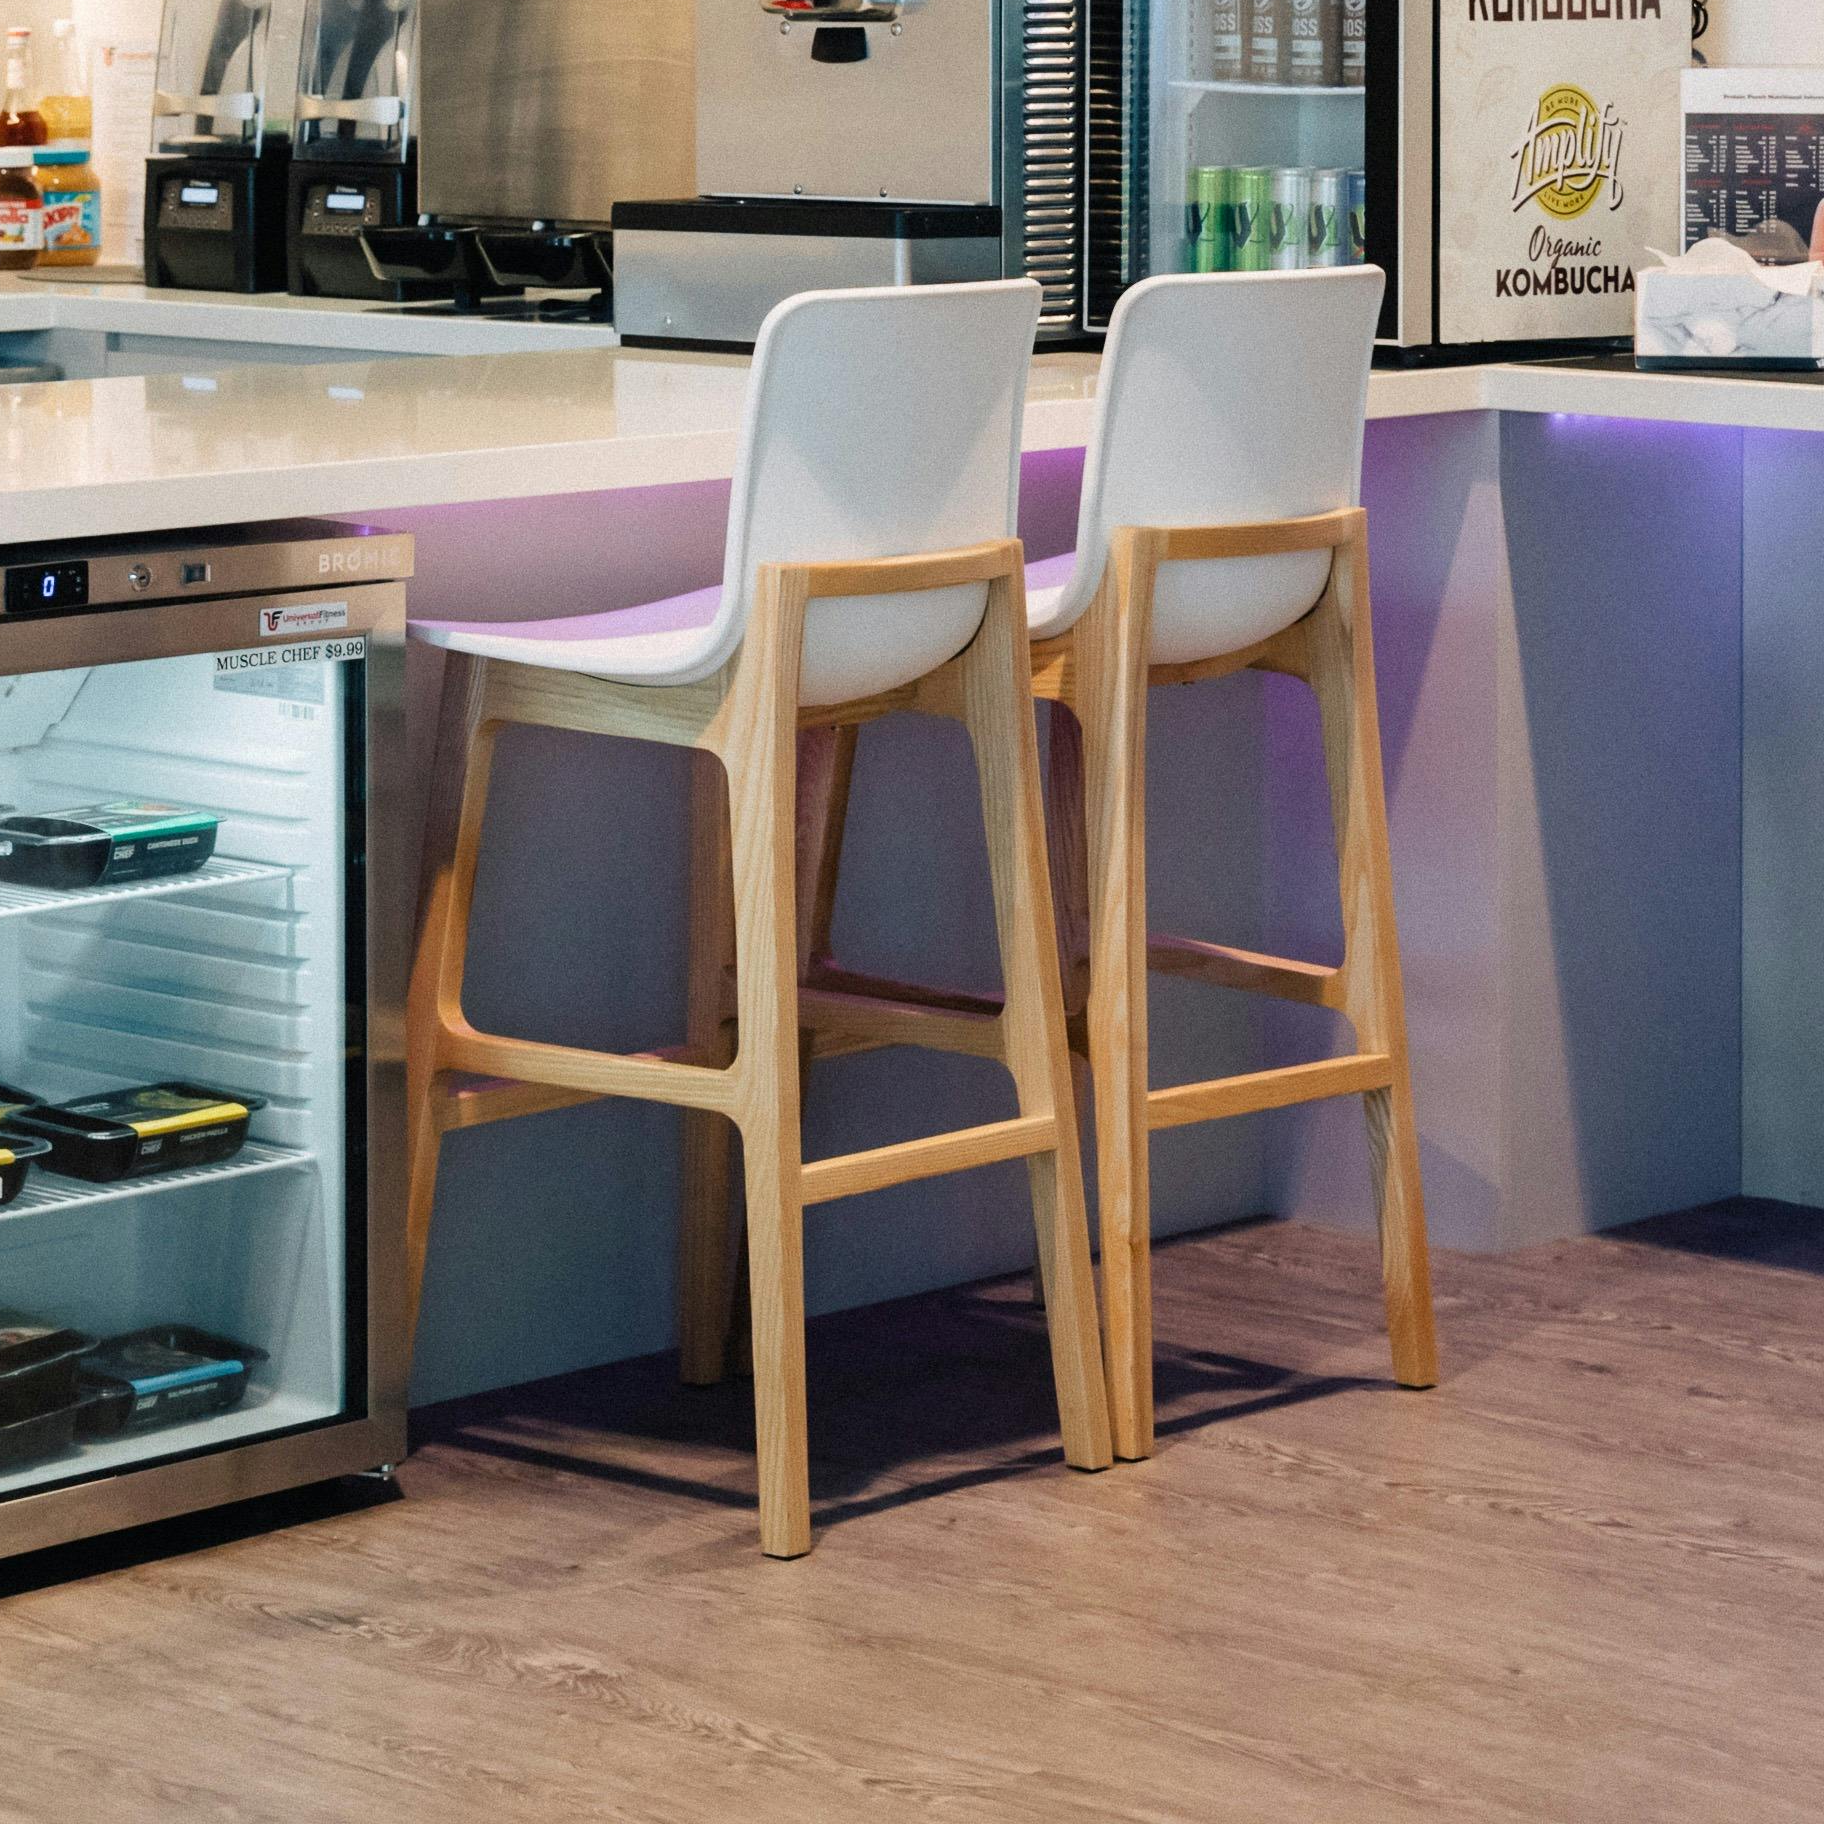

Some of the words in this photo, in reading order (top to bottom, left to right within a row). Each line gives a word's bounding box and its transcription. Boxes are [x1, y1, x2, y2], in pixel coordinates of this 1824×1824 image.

[1529, 224, 1602, 270] Organic
[1496, 265, 1636, 297] KOMBUCHA
[43, 576, 55, 597] 0
[217, 652, 277, 671] MUSCLE
[282, 646, 322, 664] CHEF
[325, 641, 363, 659] $9.99
